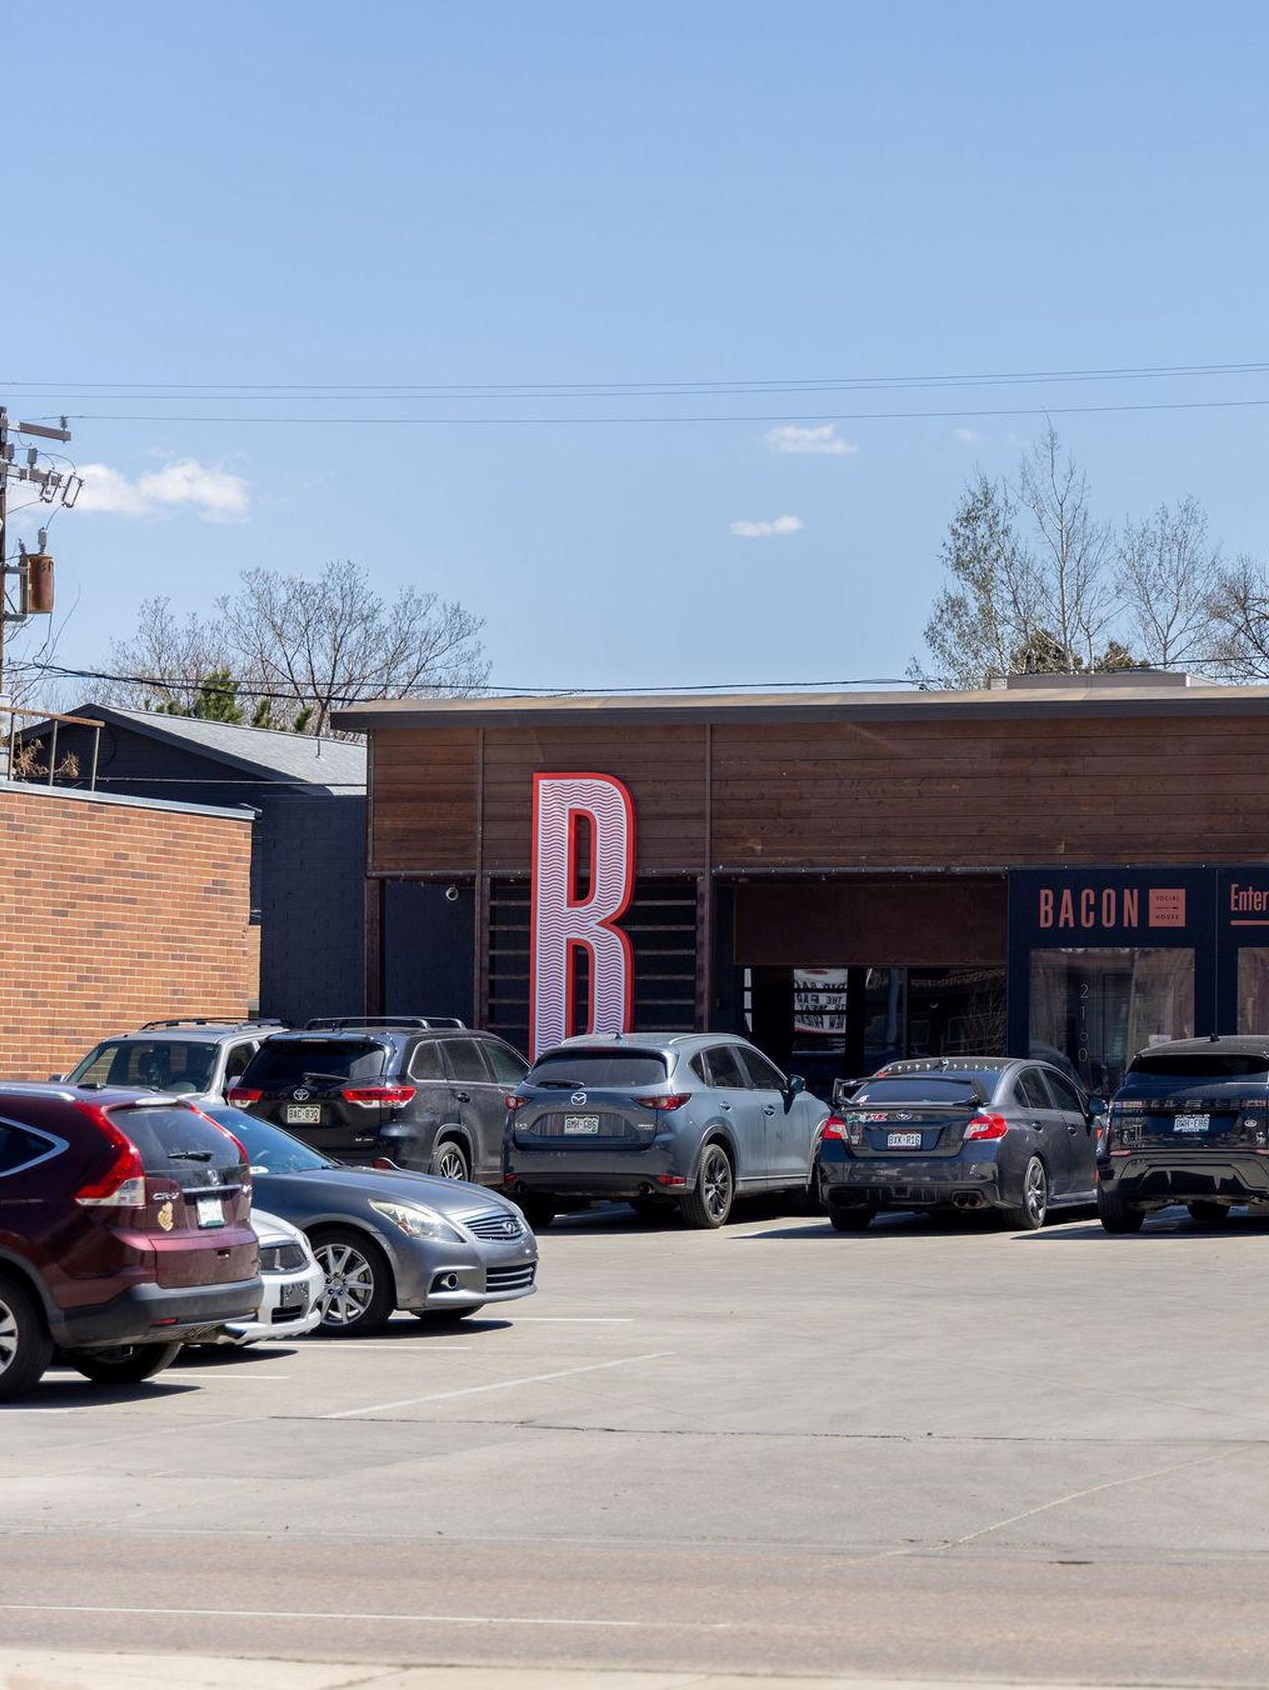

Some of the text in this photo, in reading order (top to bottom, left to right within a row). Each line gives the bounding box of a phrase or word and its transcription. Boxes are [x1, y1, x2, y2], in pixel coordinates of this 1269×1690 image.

[1039, 889, 1138, 928] BACON
[1230, 884, 1269, 911] Enter
[152, 1191, 180, 1200] CR-V
